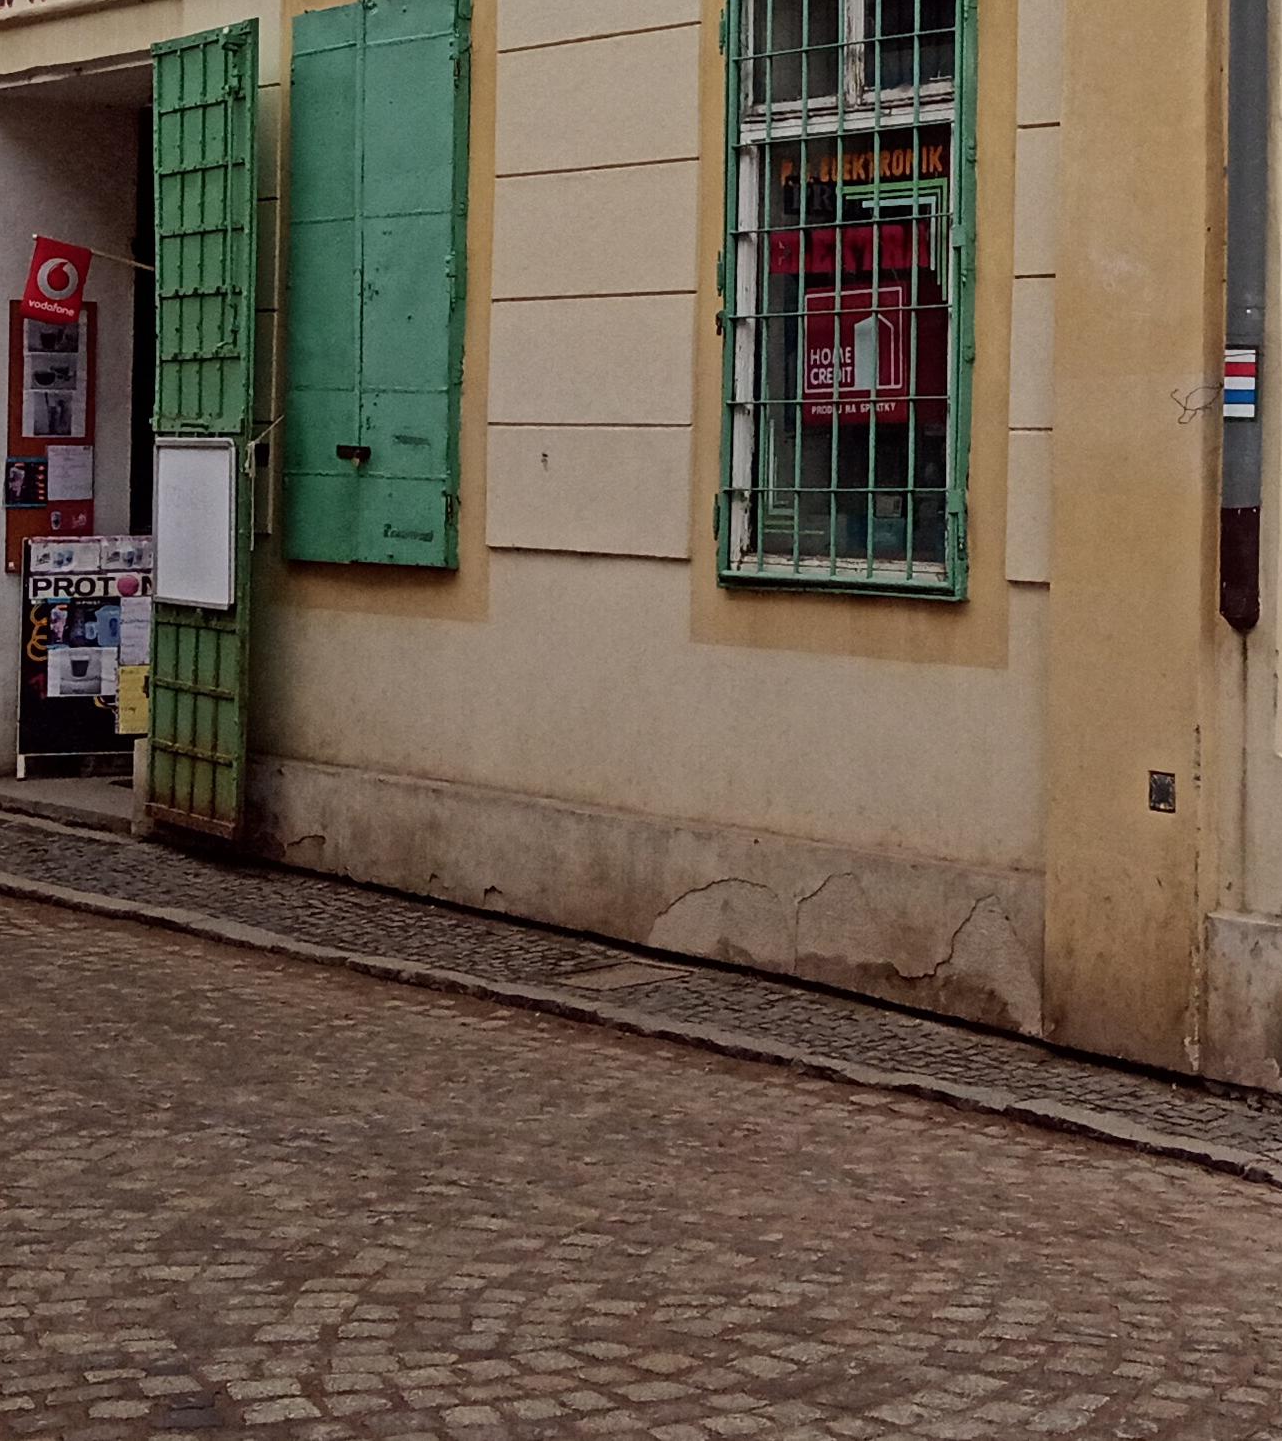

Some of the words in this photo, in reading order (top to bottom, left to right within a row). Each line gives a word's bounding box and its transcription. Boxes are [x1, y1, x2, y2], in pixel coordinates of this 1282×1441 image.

[28, 299, 75, 318] vodafone
[811, 403, 842, 415] PRODJ
[860, 401, 896, 414] SPTKY
